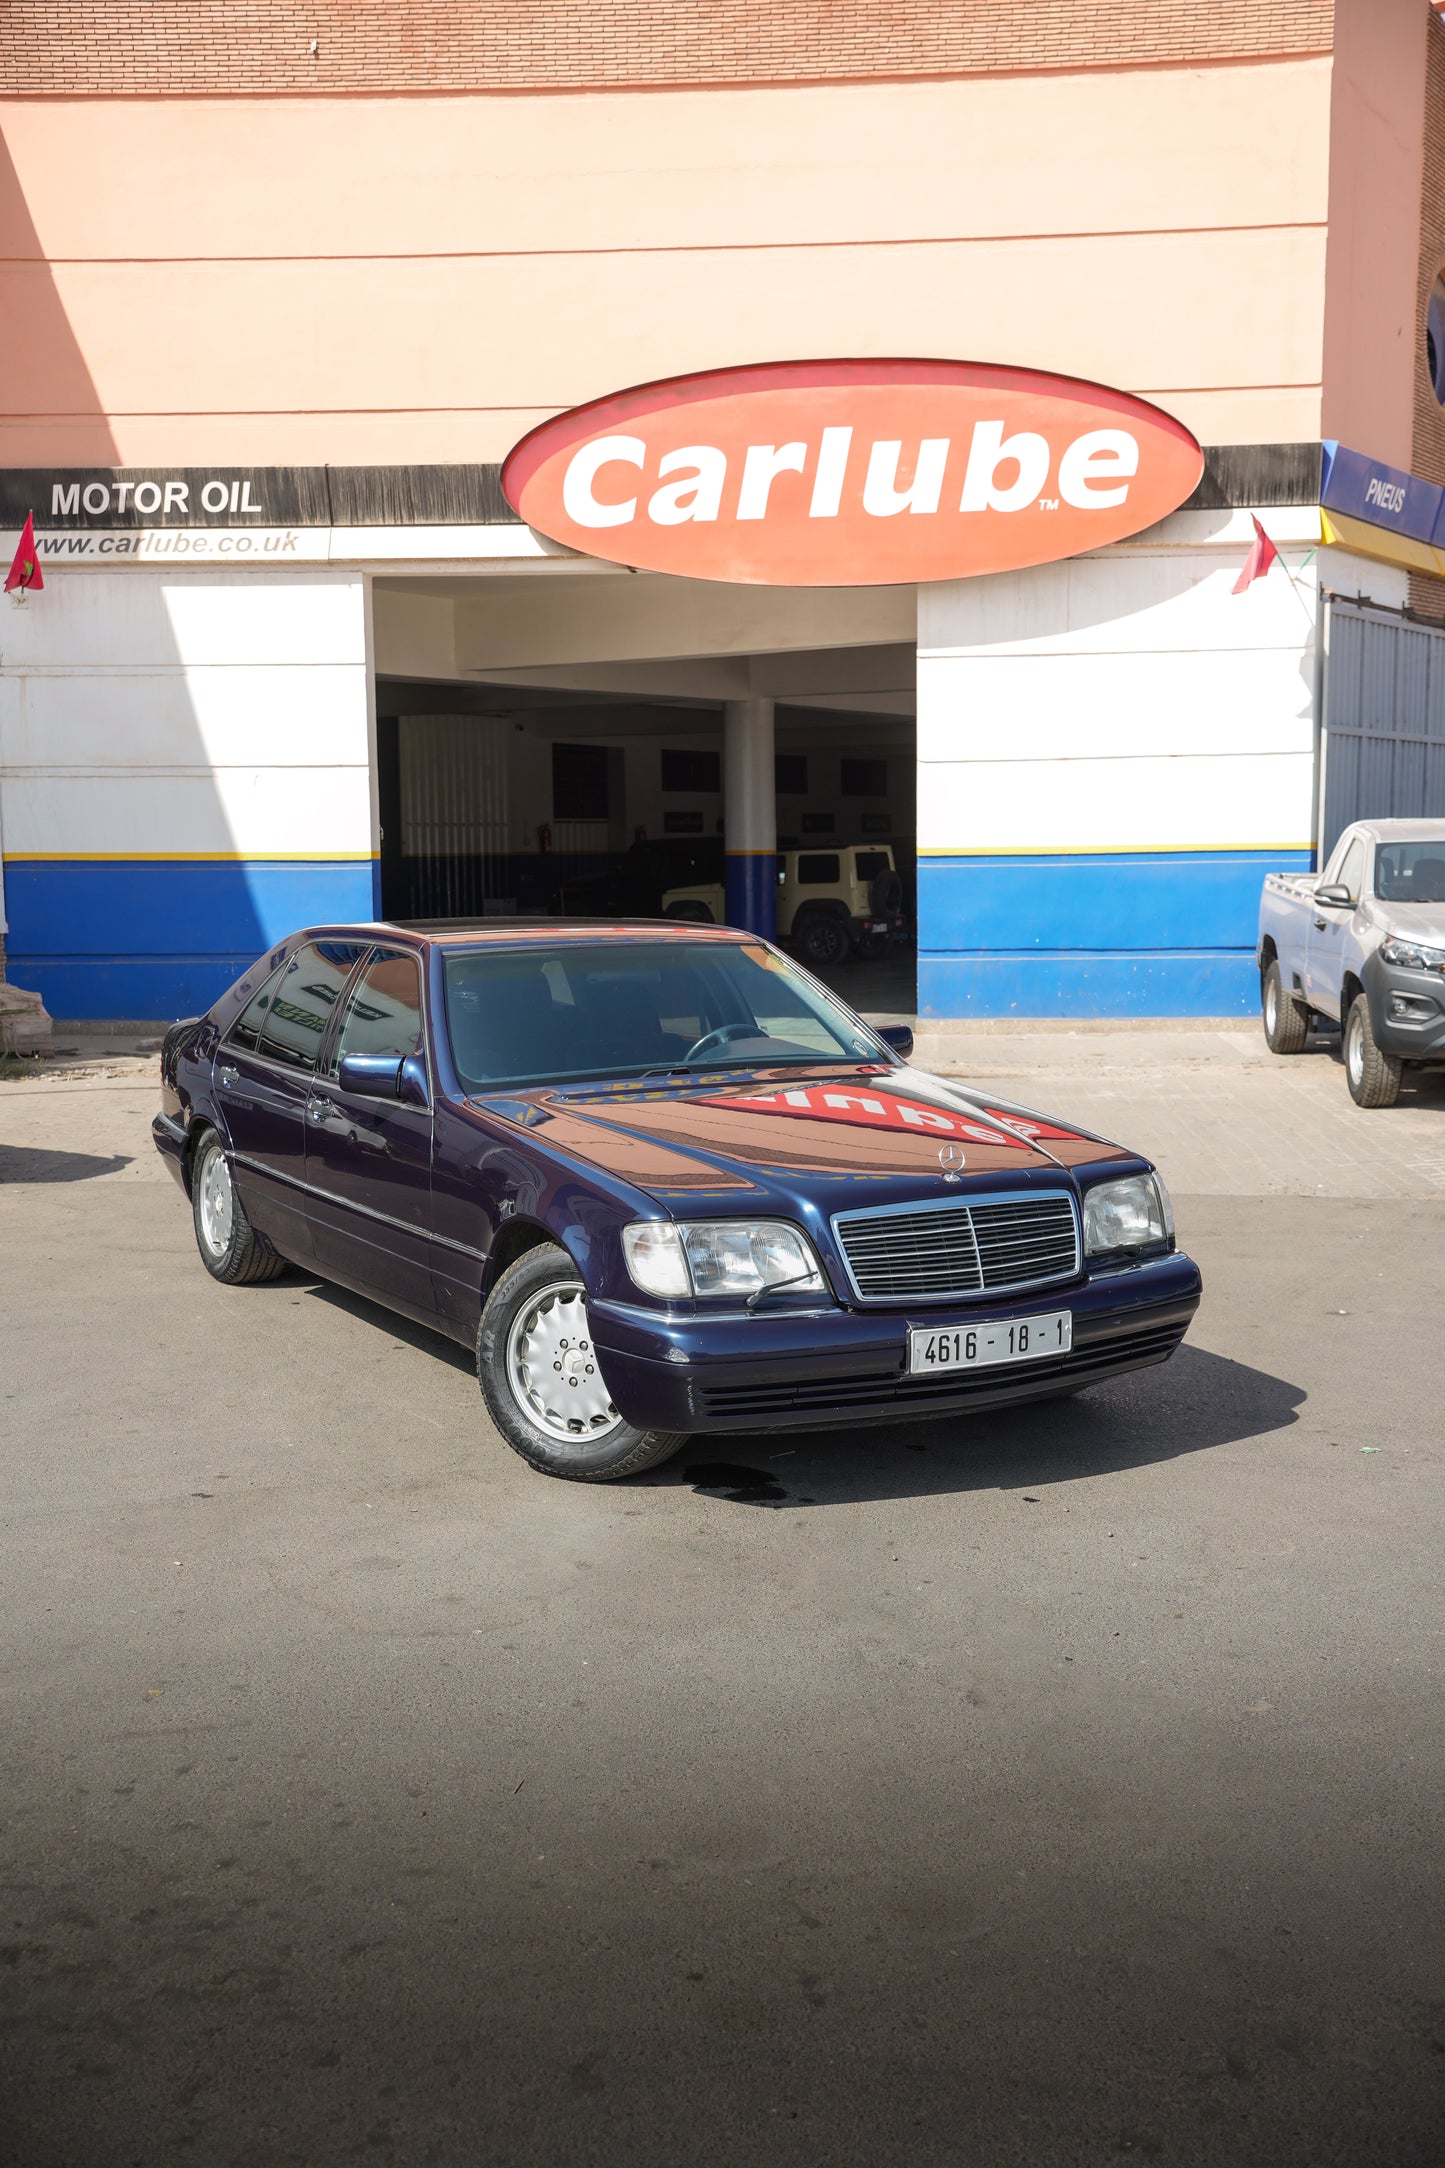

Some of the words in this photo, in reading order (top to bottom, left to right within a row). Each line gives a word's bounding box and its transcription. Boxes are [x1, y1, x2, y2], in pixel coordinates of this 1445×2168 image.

[563, 420, 1140, 528] Carlube
[1038, 498, 1060, 511] TM
[52, 481, 190, 515] MOTOR
[201, 480, 263, 513] OIL
[1364, 478, 1406, 513] PNEUS
[925, 1332, 977, 1364] 4616
[1008, 1324, 1029, 1354] 18
[1056, 1318, 1063, 1346] 1
